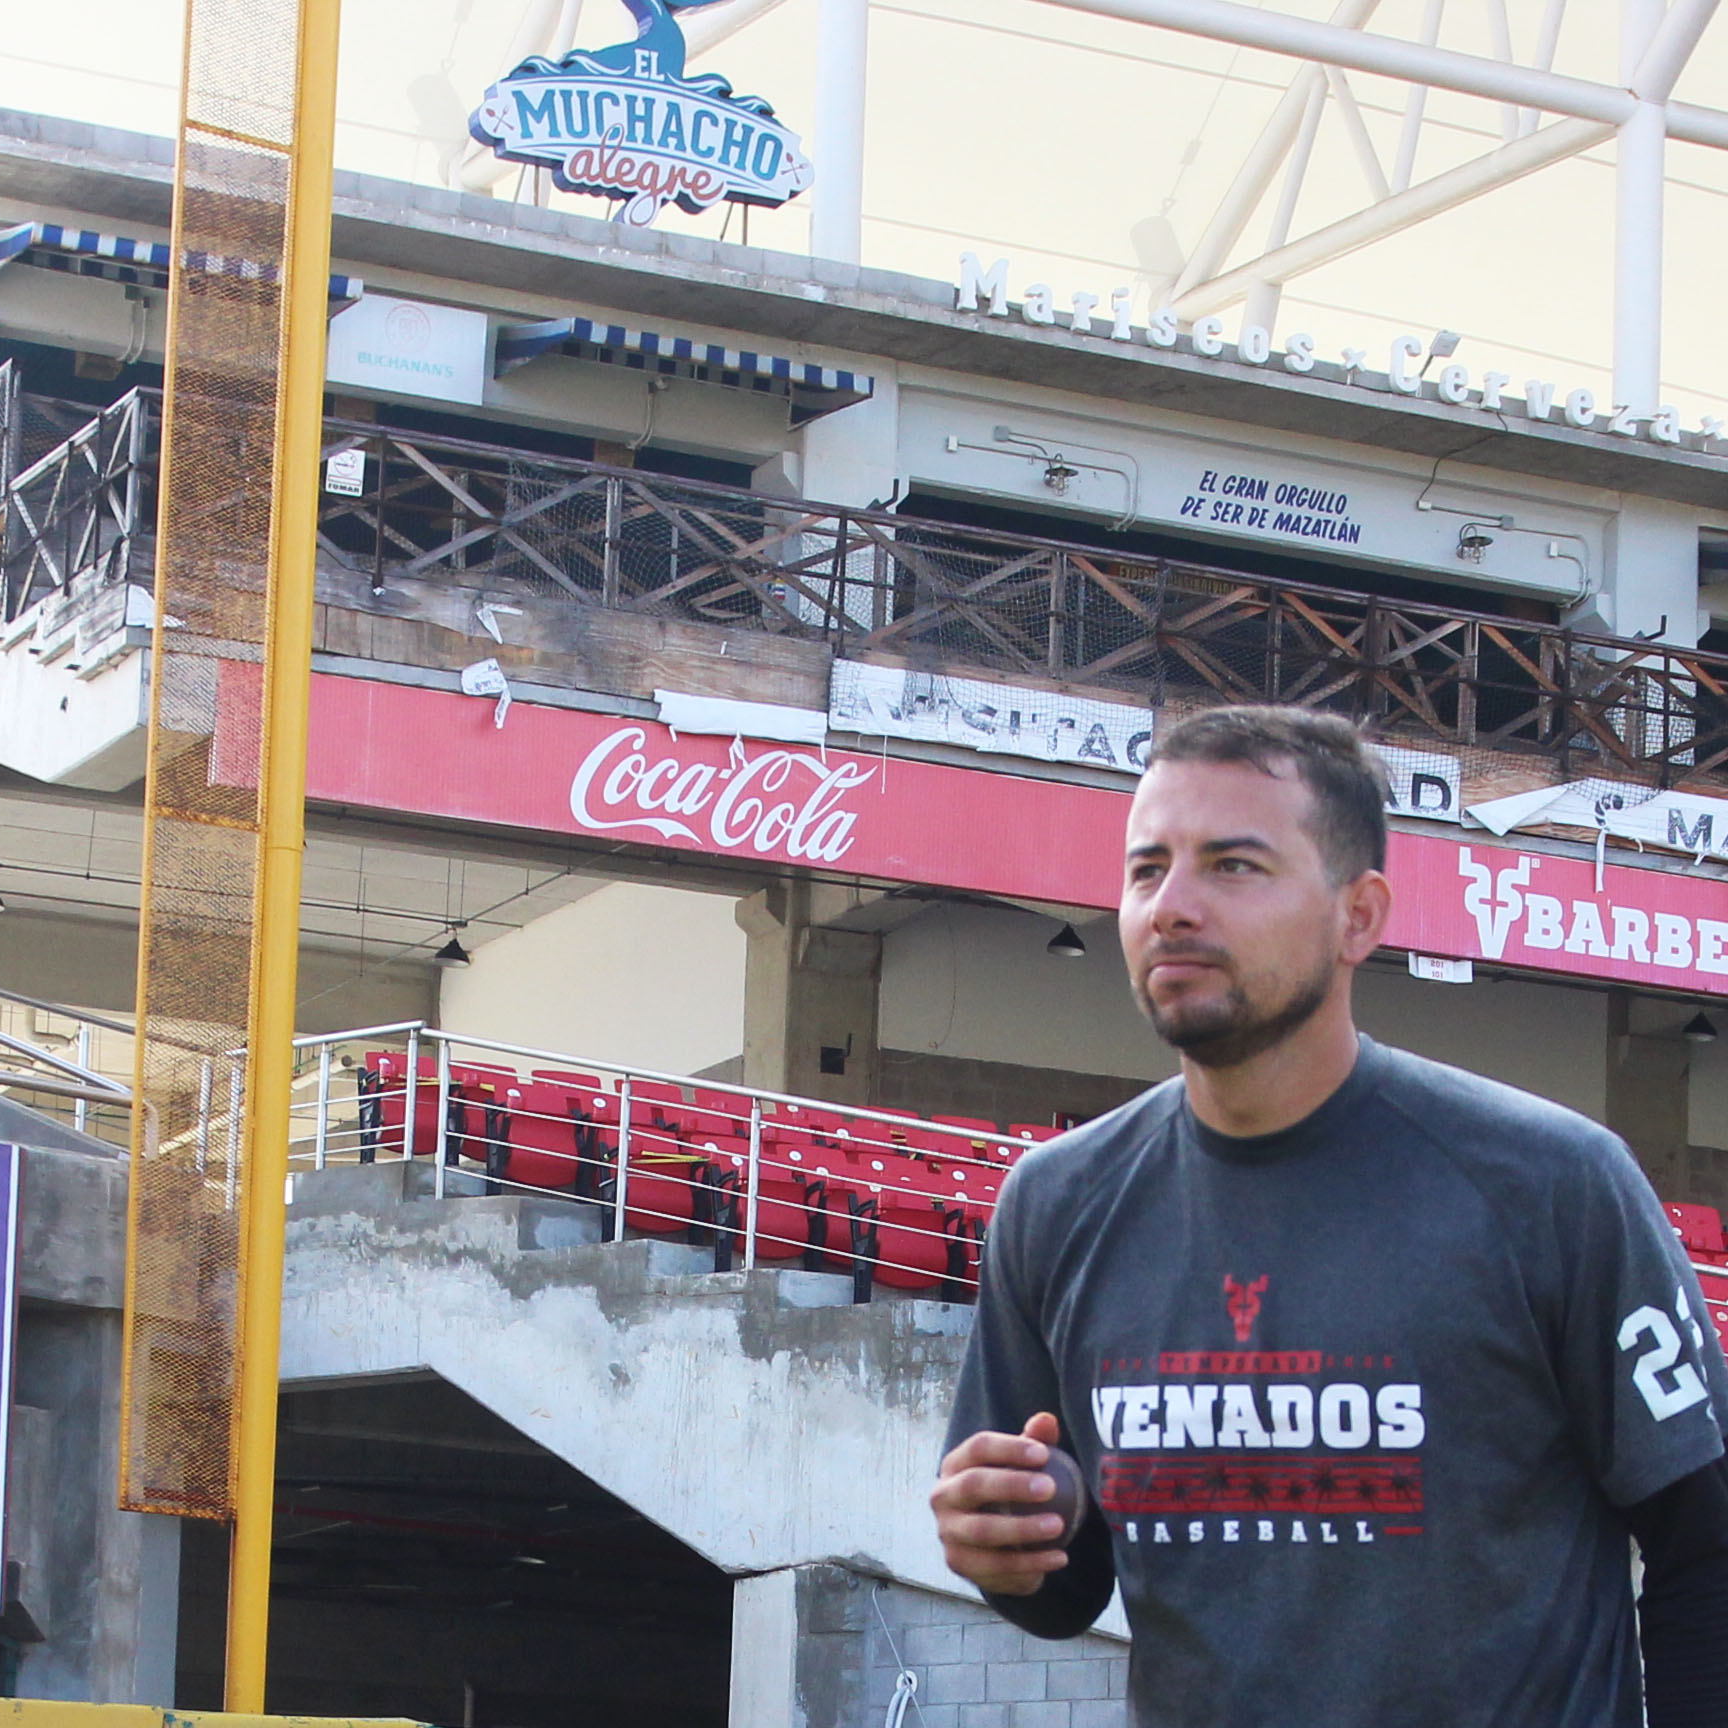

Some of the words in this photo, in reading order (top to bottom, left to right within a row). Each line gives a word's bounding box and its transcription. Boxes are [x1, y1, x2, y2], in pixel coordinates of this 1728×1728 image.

[634, 48, 665, 82] EL
[511, 88, 785, 182] MUCHACHO
[568, 122, 723, 227] alegre
[956, 250, 1315, 373] Mariscos
[1389, 335, 1680, 444] Cerveza
[1180, 496, 1206, 518] DE
[1210, 501, 1244, 524] SER
[1247, 506, 1269, 529] DE
[1272, 511, 1361, 544] MAZATLÁN
[1199, 470, 1218, 493] EL
[1222, 475, 1269, 502] GRAN
[1274, 483, 1347, 515] ORGULLO
[570, 727, 878, 862] Coca-Cola
[1092, 1383, 1427, 1449] VENADOS
[1126, 1521, 1375, 1544] BASEBALL
